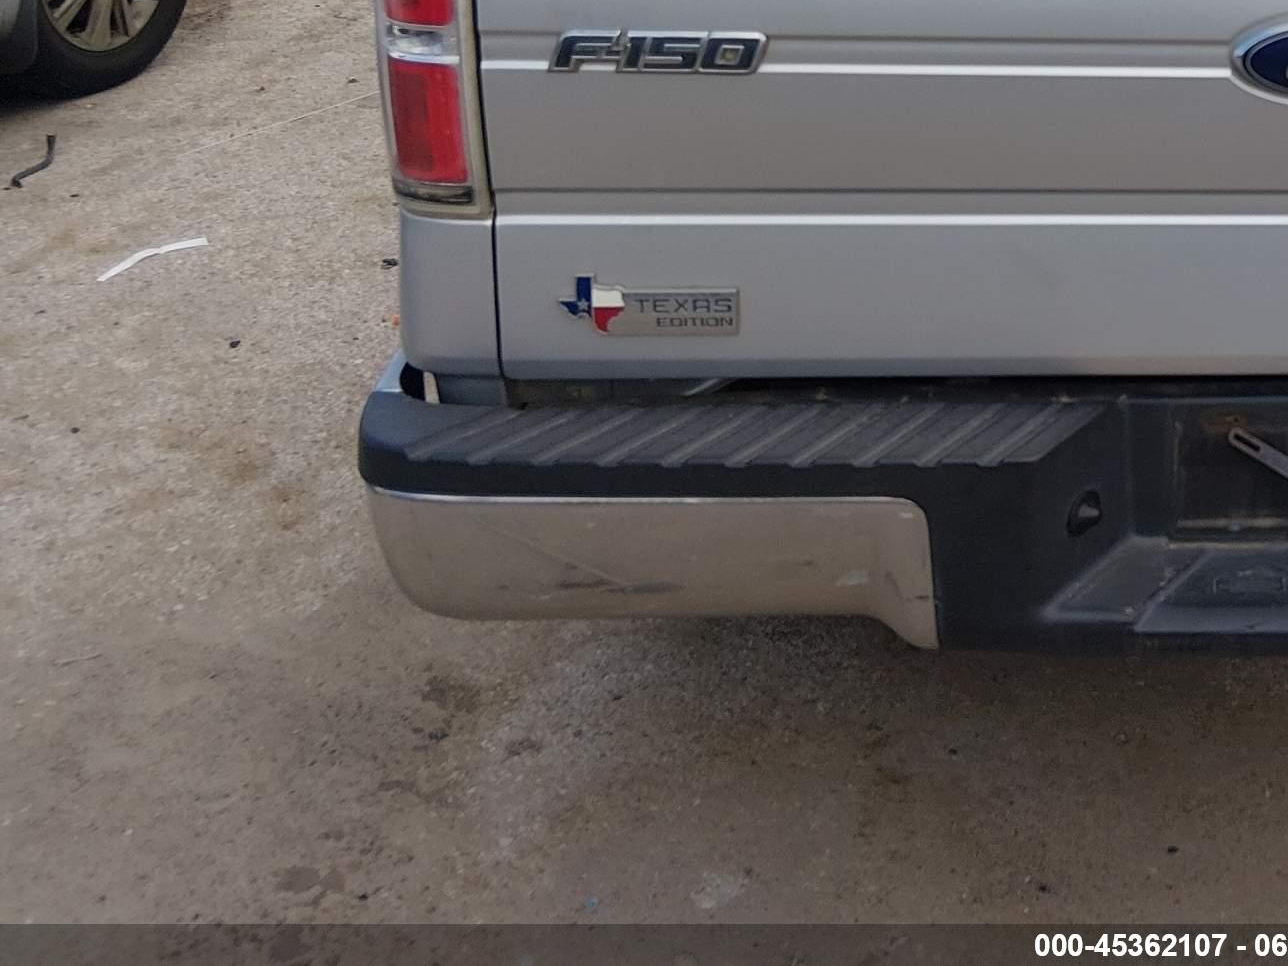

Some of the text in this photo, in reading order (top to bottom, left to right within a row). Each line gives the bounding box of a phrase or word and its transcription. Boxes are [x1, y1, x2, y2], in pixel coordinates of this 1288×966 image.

[549, 30, 768, 74] F-150
[635, 298, 732, 313] TEXAS
[656, 317, 733, 327] EDITION
